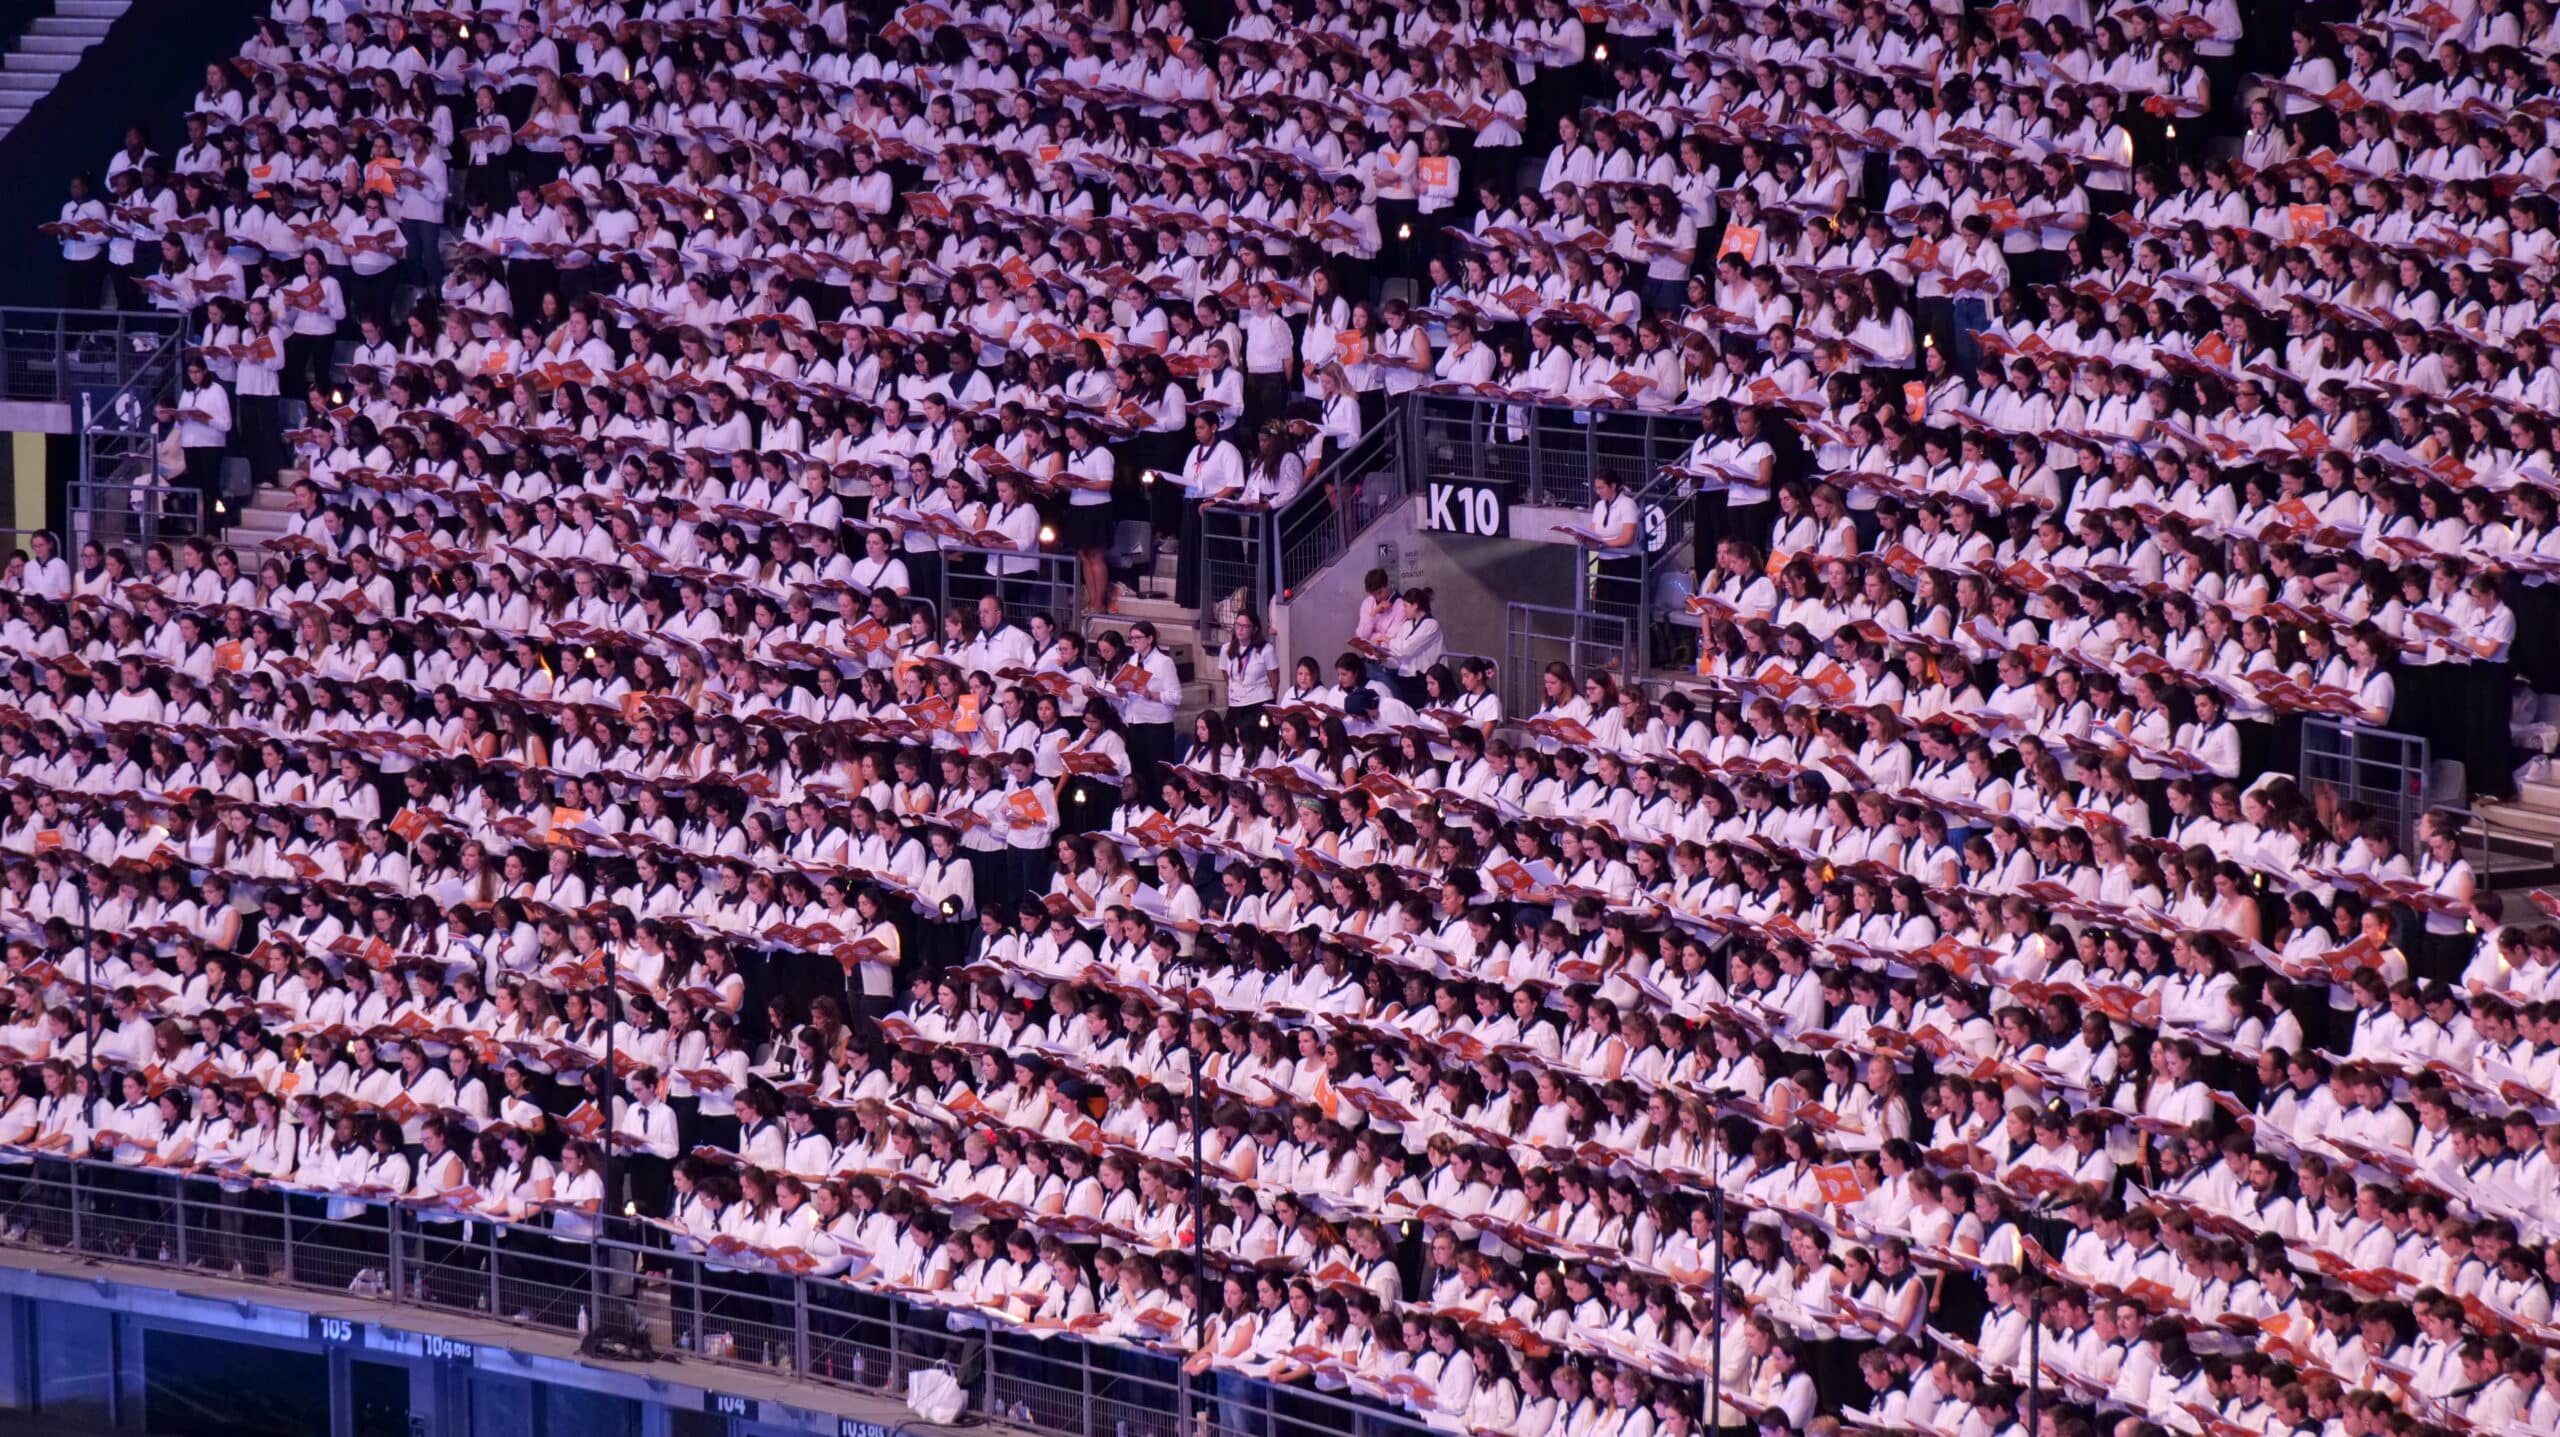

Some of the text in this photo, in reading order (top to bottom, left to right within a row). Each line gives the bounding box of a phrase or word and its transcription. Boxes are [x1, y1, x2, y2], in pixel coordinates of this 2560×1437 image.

[1645, 504, 1667, 552] 9
[320, 1318, 352, 1341] 105
[718, 1396, 745, 1415] 104
